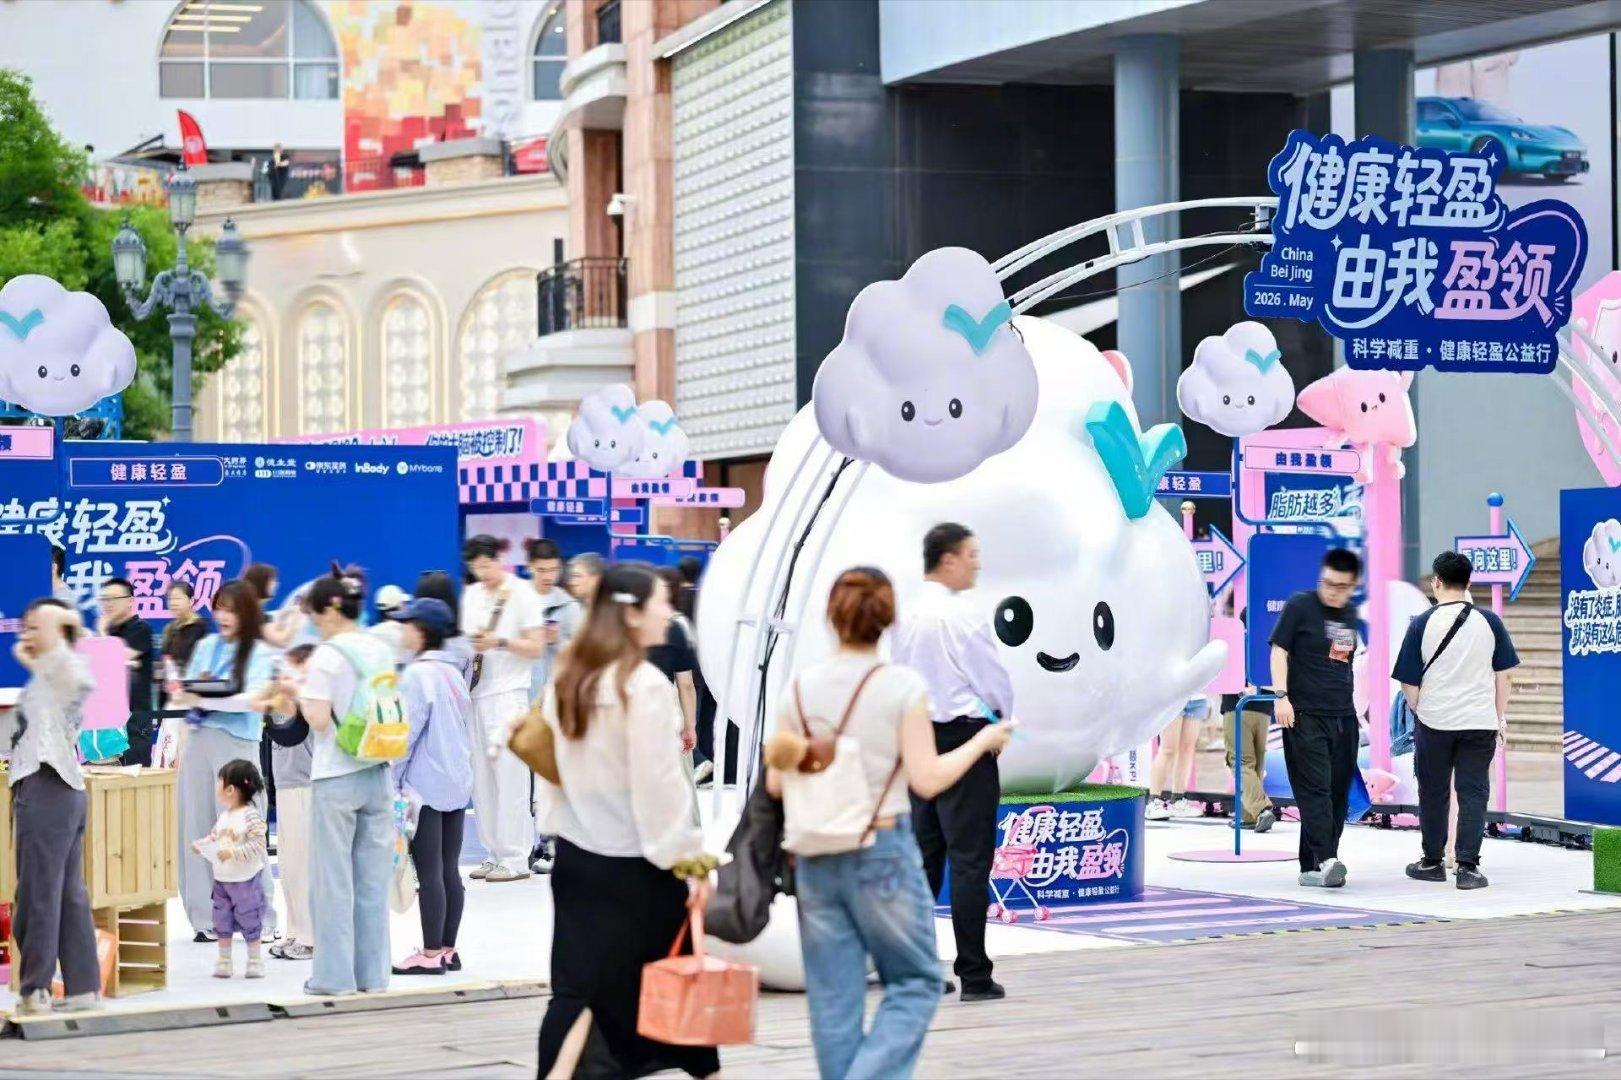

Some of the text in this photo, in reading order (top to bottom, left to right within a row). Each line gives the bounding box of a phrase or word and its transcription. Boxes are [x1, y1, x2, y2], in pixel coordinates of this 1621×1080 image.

[1282, 142, 1500, 230] 健康轻盈
[1281, 247, 1313, 261] China
[1326, 234, 1556, 327] 由我盈领
[1255, 292, 1281, 306] 2026
[1289, 293, 1314, 311] May
[1353, 338, 1419, 361] 科学减重
[1440, 340, 1551, 364] 健康轻盈公益行
[355, 462, 389, 475] InBody
[1276, 451, 1332, 468] 由我盈领
[111, 463, 187, 481] 健康轻盈
